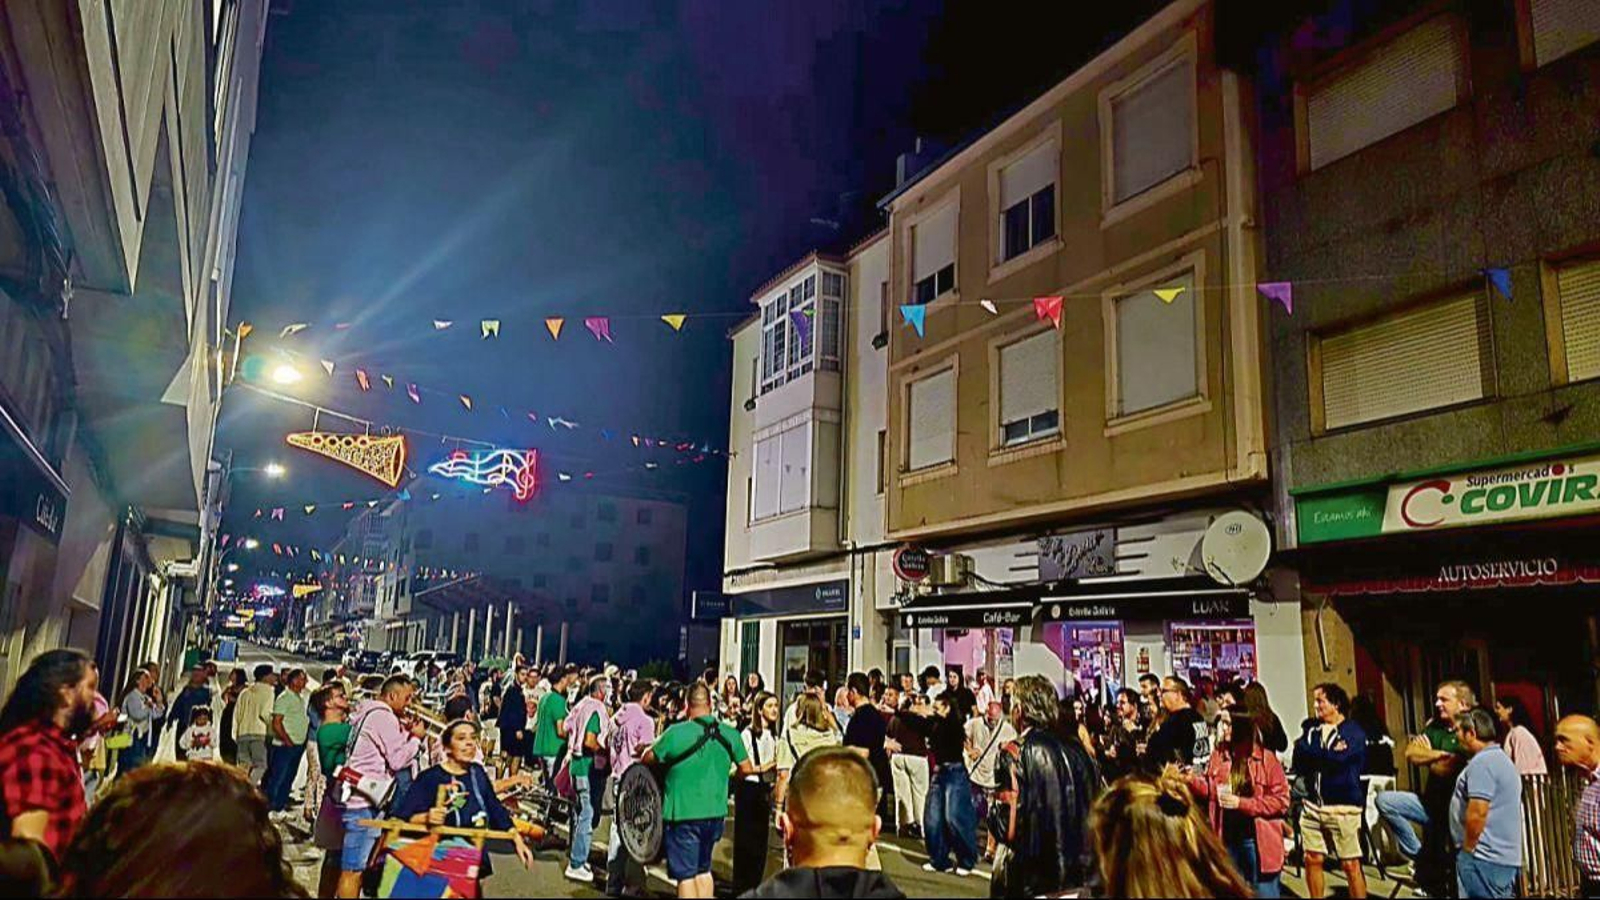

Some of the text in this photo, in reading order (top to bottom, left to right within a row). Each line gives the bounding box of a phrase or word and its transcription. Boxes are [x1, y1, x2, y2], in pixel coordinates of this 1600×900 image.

[1460, 474, 1600, 514] COVIR
[1438, 558, 1558, 582] AUTOSERVICIO
[983, 611, 1021, 624] Café-Bar
